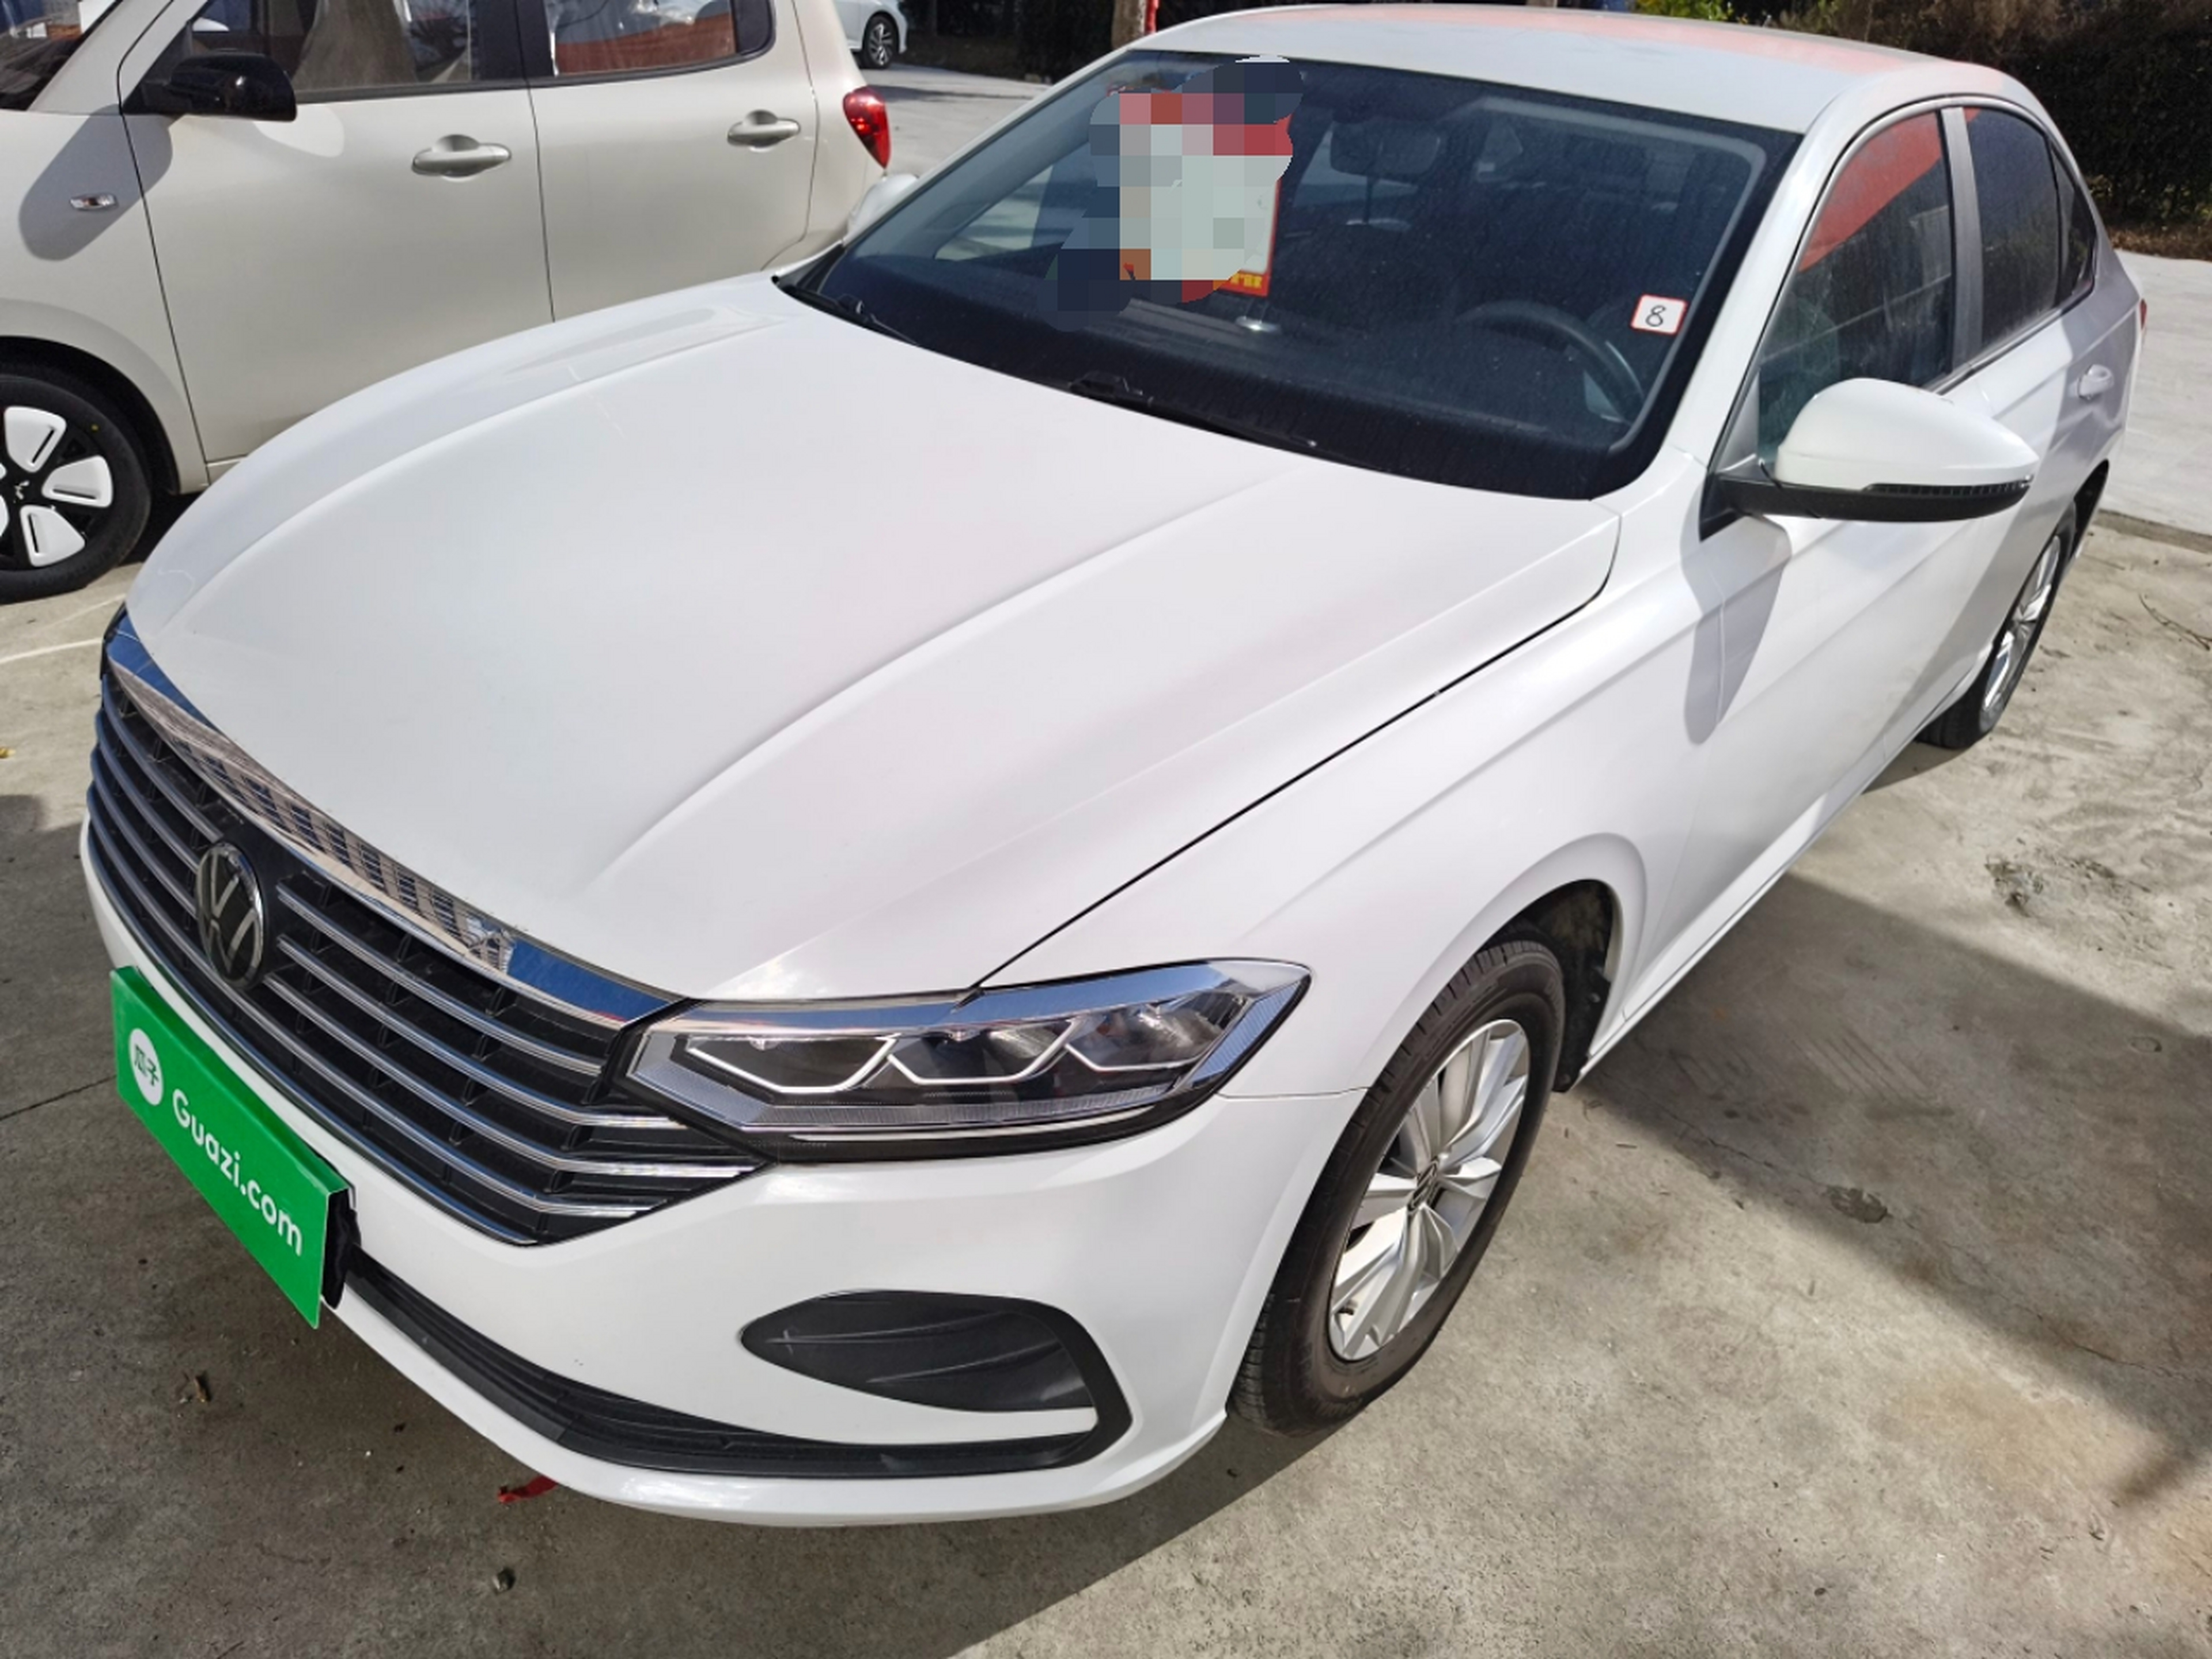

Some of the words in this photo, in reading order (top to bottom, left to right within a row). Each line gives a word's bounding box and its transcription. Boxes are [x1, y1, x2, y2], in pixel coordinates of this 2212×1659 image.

[1645, 305, 1666, 327] 8
[134, 1044, 160, 1087] 瓜子
[172, 1088, 303, 1257] Guazi.com
